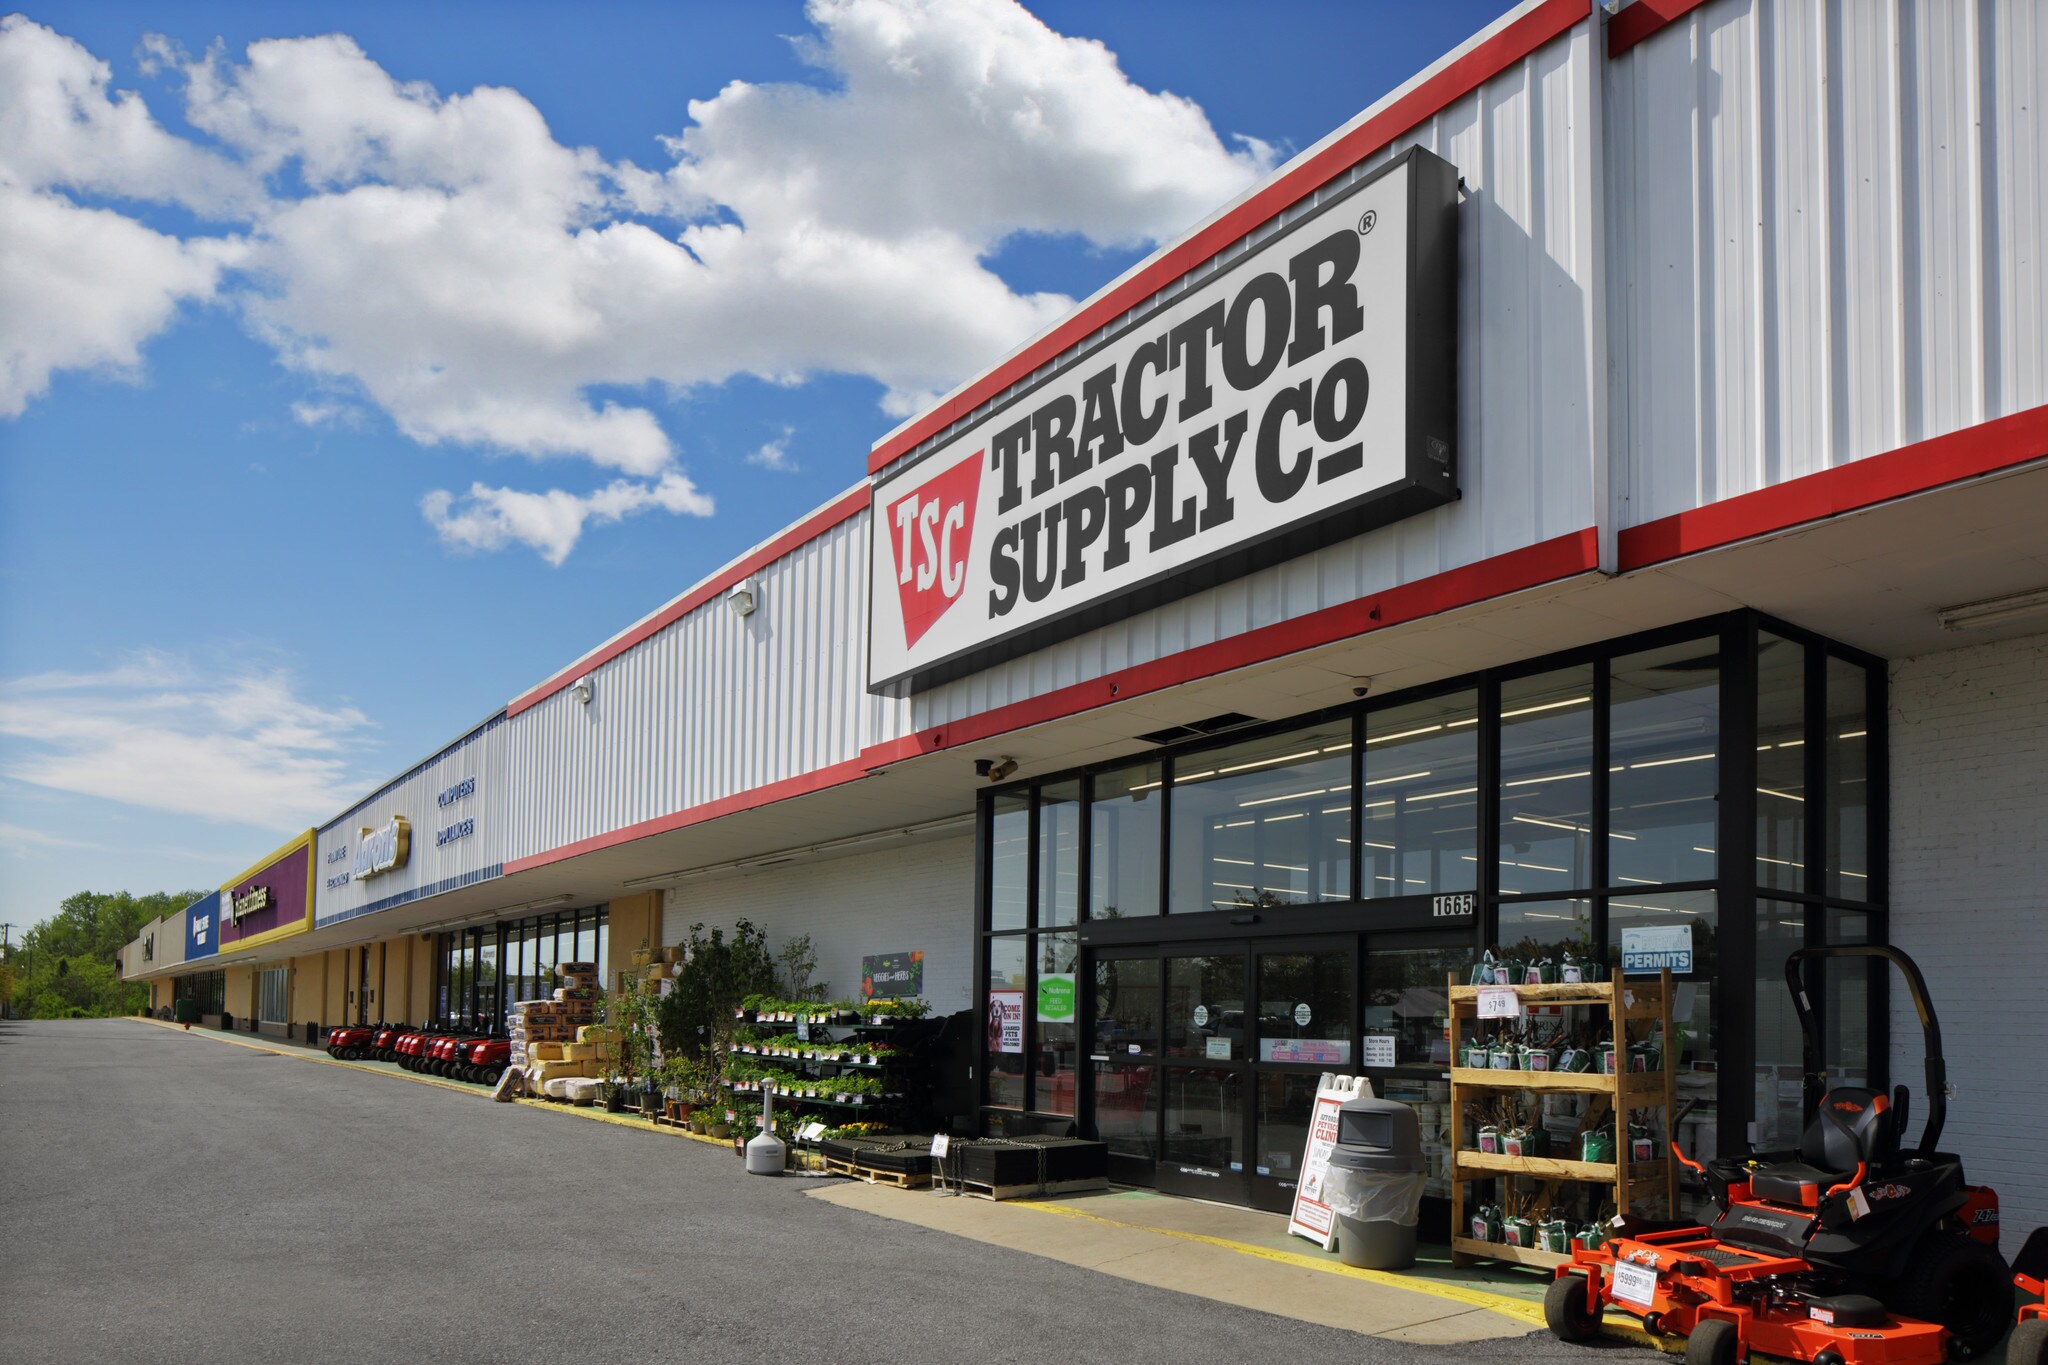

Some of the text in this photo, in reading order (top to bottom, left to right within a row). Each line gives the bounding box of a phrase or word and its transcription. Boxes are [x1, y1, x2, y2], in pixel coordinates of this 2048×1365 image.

[991, 228, 1364, 516] TRACTOR
[988, 410, 1248, 620] SUPPLY
[896, 493, 966, 599] TSC
[1435, 895, 1471, 916] 1665
[1625, 952, 1689, 969] PERMITS
[873, 972, 890, 983] VEGGIES
[1003, 1004, 1021, 1013] COME
[1003, 1012, 1011, 1020] ON
[1315, 1128, 1337, 1143] CLINI
